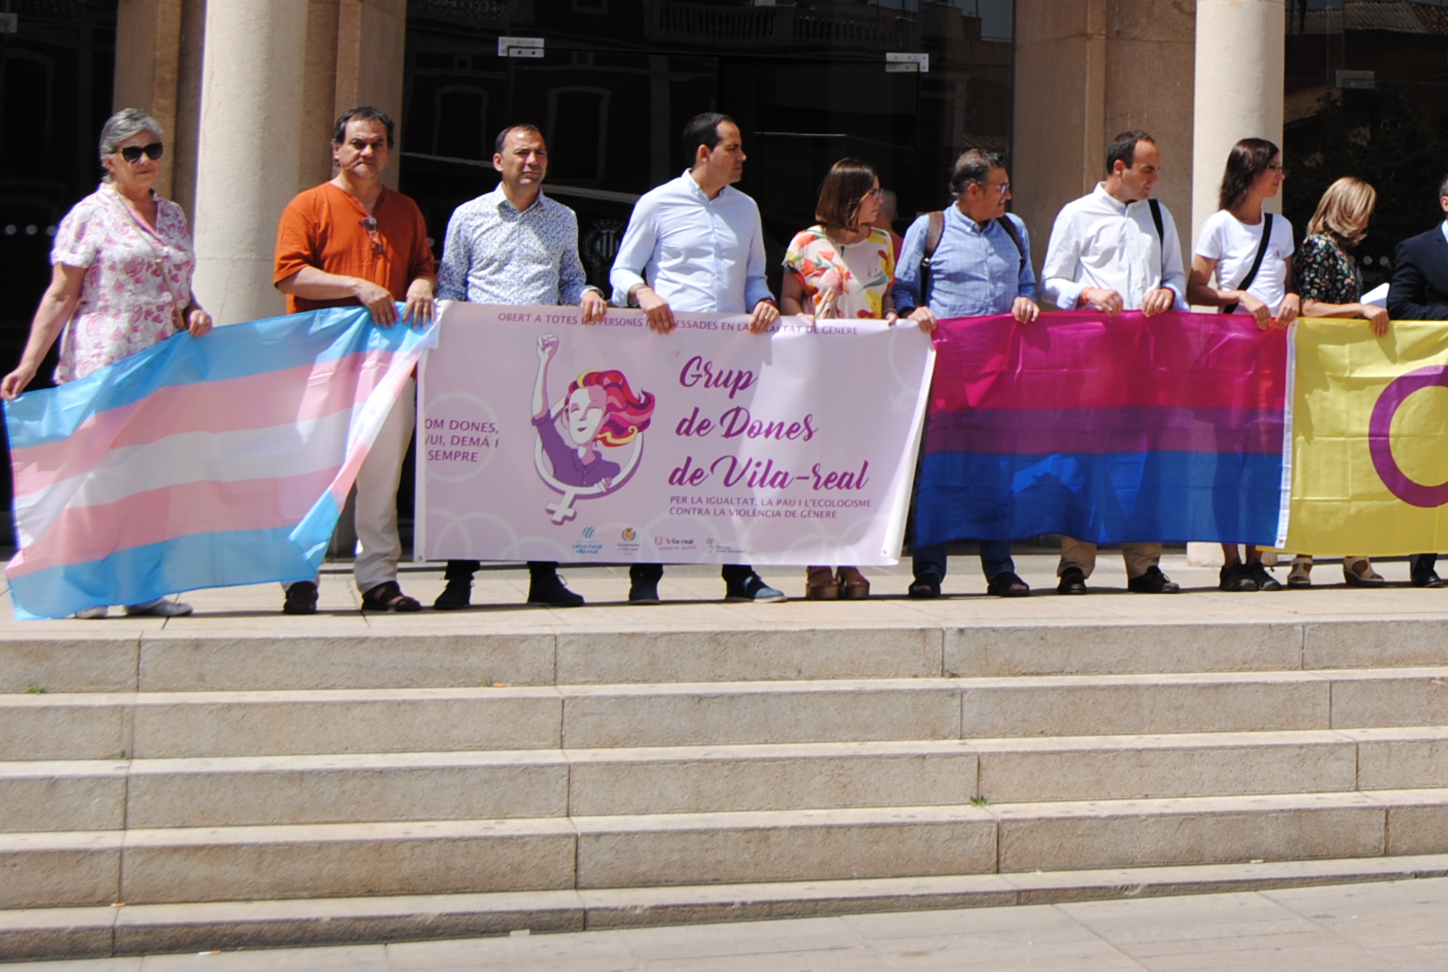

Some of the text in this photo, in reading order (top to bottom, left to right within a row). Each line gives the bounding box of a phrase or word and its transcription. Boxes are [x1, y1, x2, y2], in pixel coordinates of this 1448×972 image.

[497, 312, 531, 323] OBERT
[534, 314, 542, 323] A
[545, 315, 578, 325] TOTES
[600, 317, 643, 327] ERSONES
[721, 322, 734, 331] EN
[679, 355, 759, 400] Grup
[424, 418, 499, 435] OM DONES,
[675, 405, 819, 442] de Dones
[494, 438, 499, 448] I
[427, 449, 479, 463] SEMPRE
[667, 455, 870, 491] de Vila-real
[670, 495, 688, 505] PER
[690, 495, 703, 505] LA
[706, 496, 758, 507] IGUALTAT,
[761, 497, 774, 507] LA
[776, 498, 796, 507] PAU
[804, 498, 872, 508] L'ECOLOGISME
[669, 506, 711, 516] CONTRA
[713, 507, 726, 517] LA
[784, 509, 798, 519] DE
